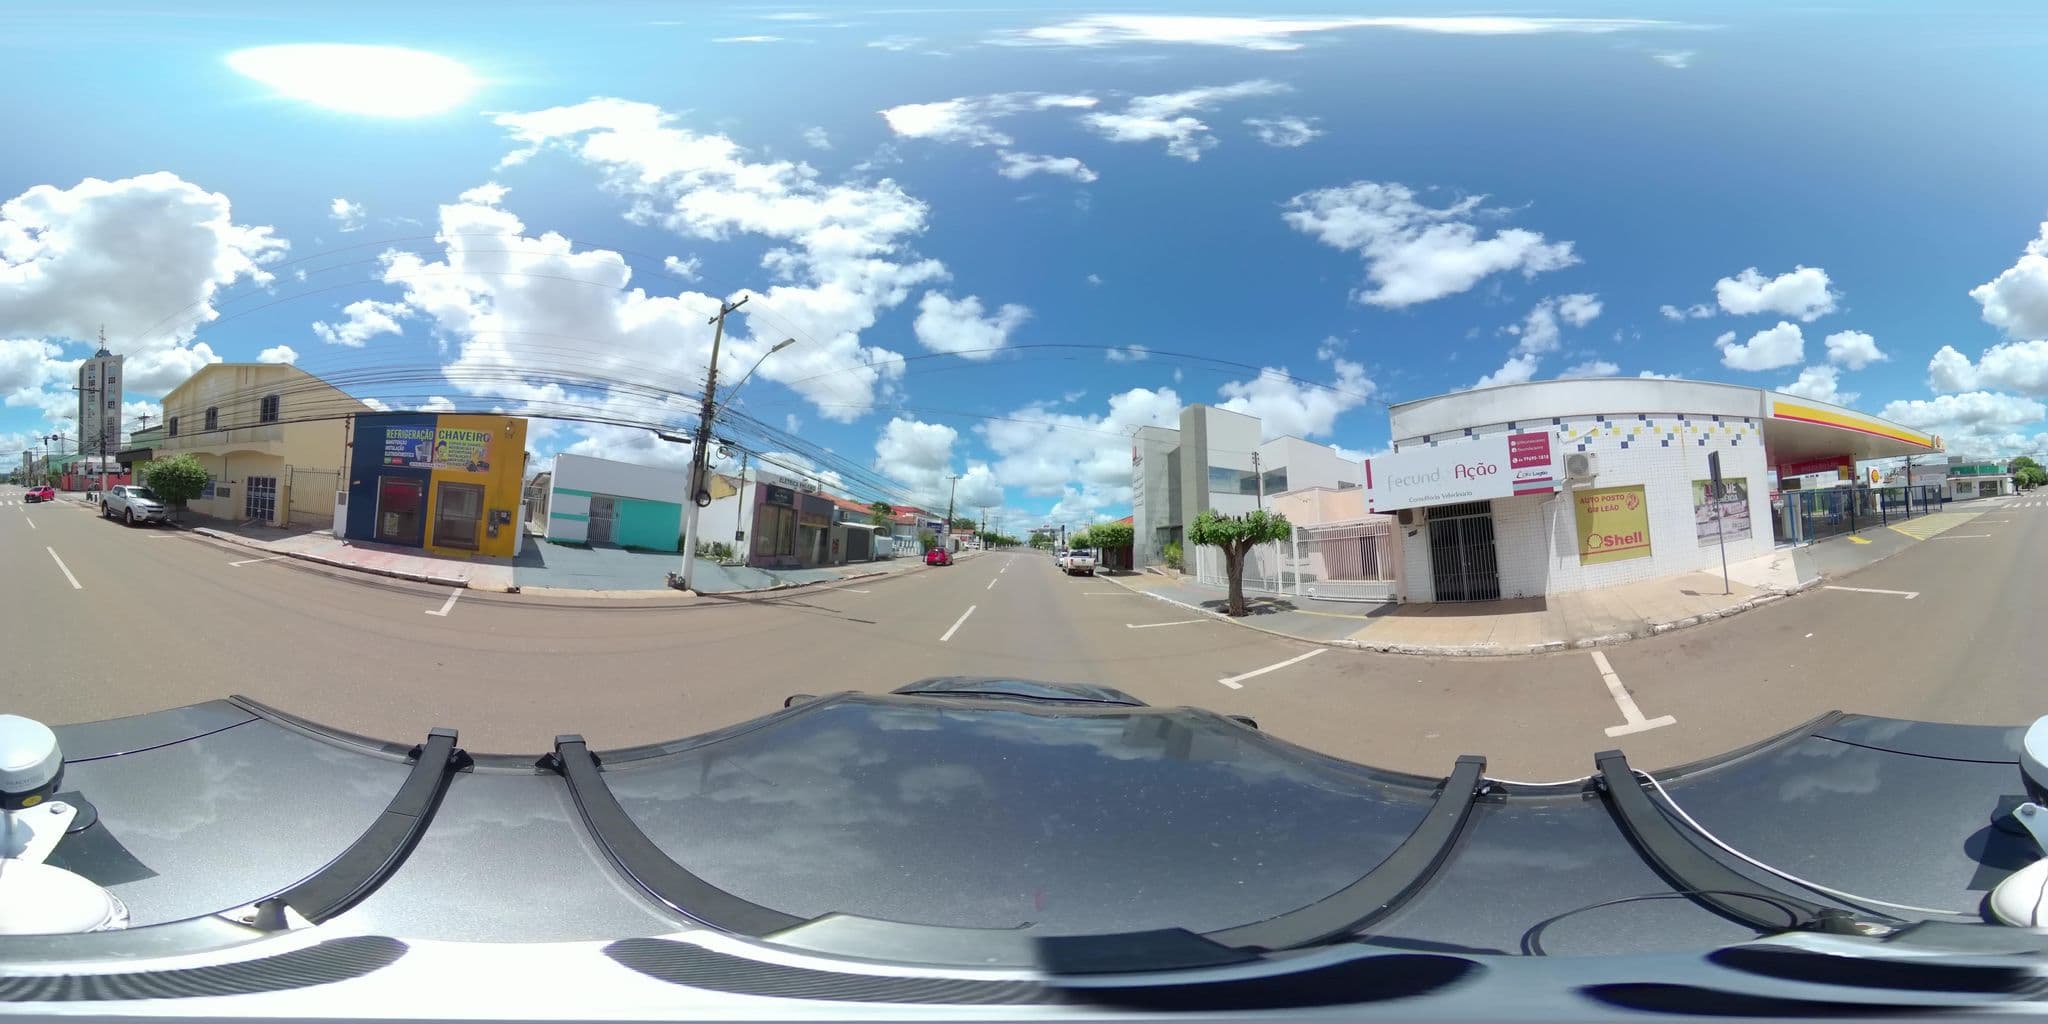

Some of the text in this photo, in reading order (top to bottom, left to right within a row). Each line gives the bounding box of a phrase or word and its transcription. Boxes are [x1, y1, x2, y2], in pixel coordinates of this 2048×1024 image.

[386, 429, 434, 440] REFRIGERAÇÃO
[439, 430, 491, 442] CHAVEIRO
[1455, 462, 1497, 480] Ação
[1580, 494, 1625, 504] AUTO POSTO
[1604, 531, 1642, 547] Shell
